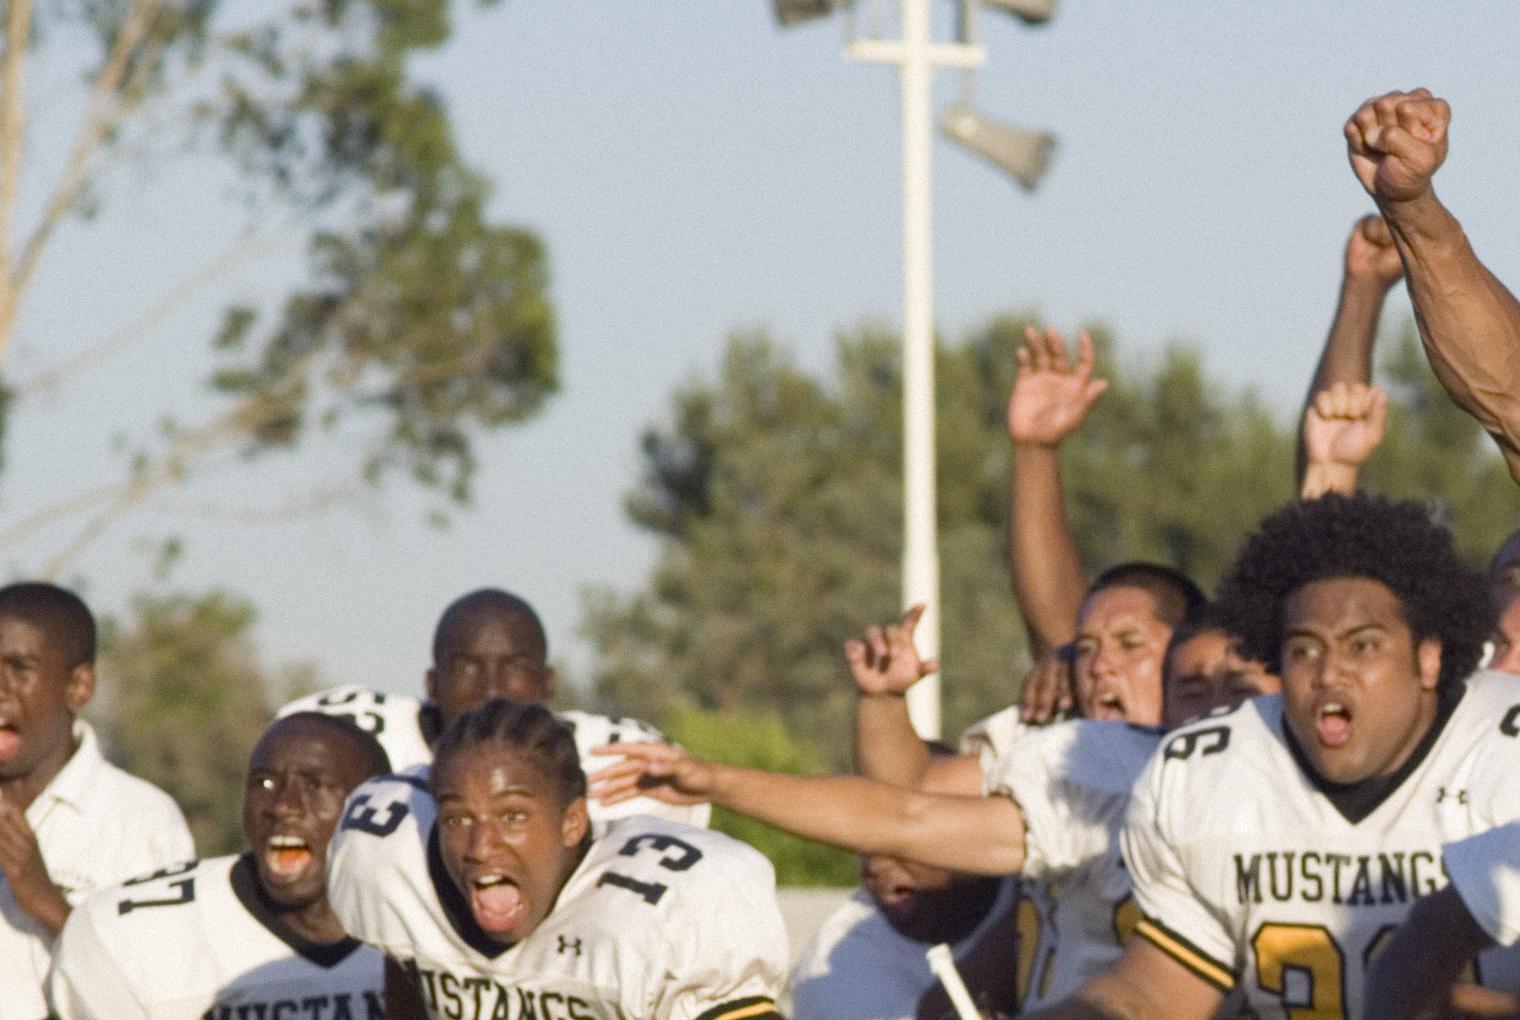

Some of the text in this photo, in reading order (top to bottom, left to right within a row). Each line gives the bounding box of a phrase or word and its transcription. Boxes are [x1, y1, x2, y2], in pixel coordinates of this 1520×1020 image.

[118, 861, 200, 916] 7
[595, 834, 704, 906] 13
[1234, 851, 1449, 904] MUSTANG
